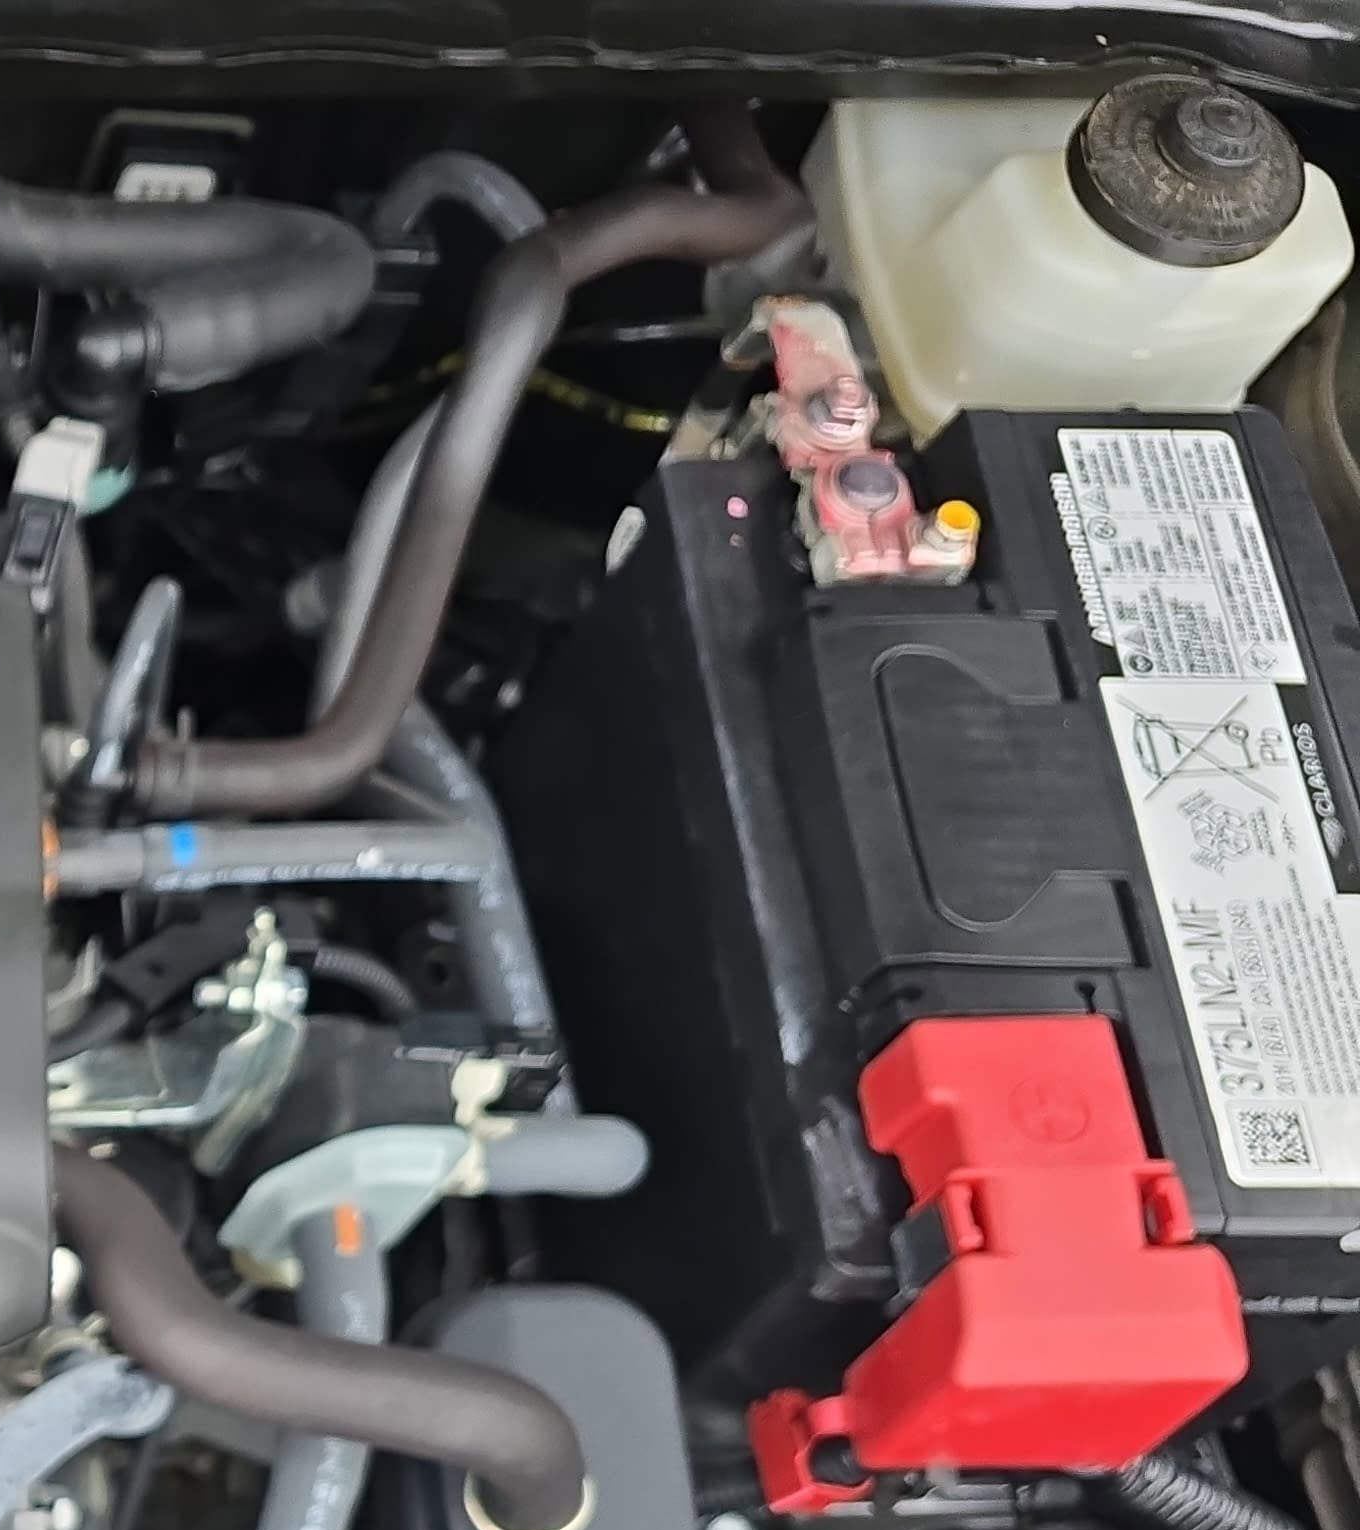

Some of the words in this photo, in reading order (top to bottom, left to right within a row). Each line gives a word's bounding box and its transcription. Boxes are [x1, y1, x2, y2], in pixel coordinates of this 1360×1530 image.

[1258, 726, 1288, 766] Pb
[1292, 722, 1335, 818] CLARIOS
[1172, 897, 1265, 1096] 375LN2-MF
